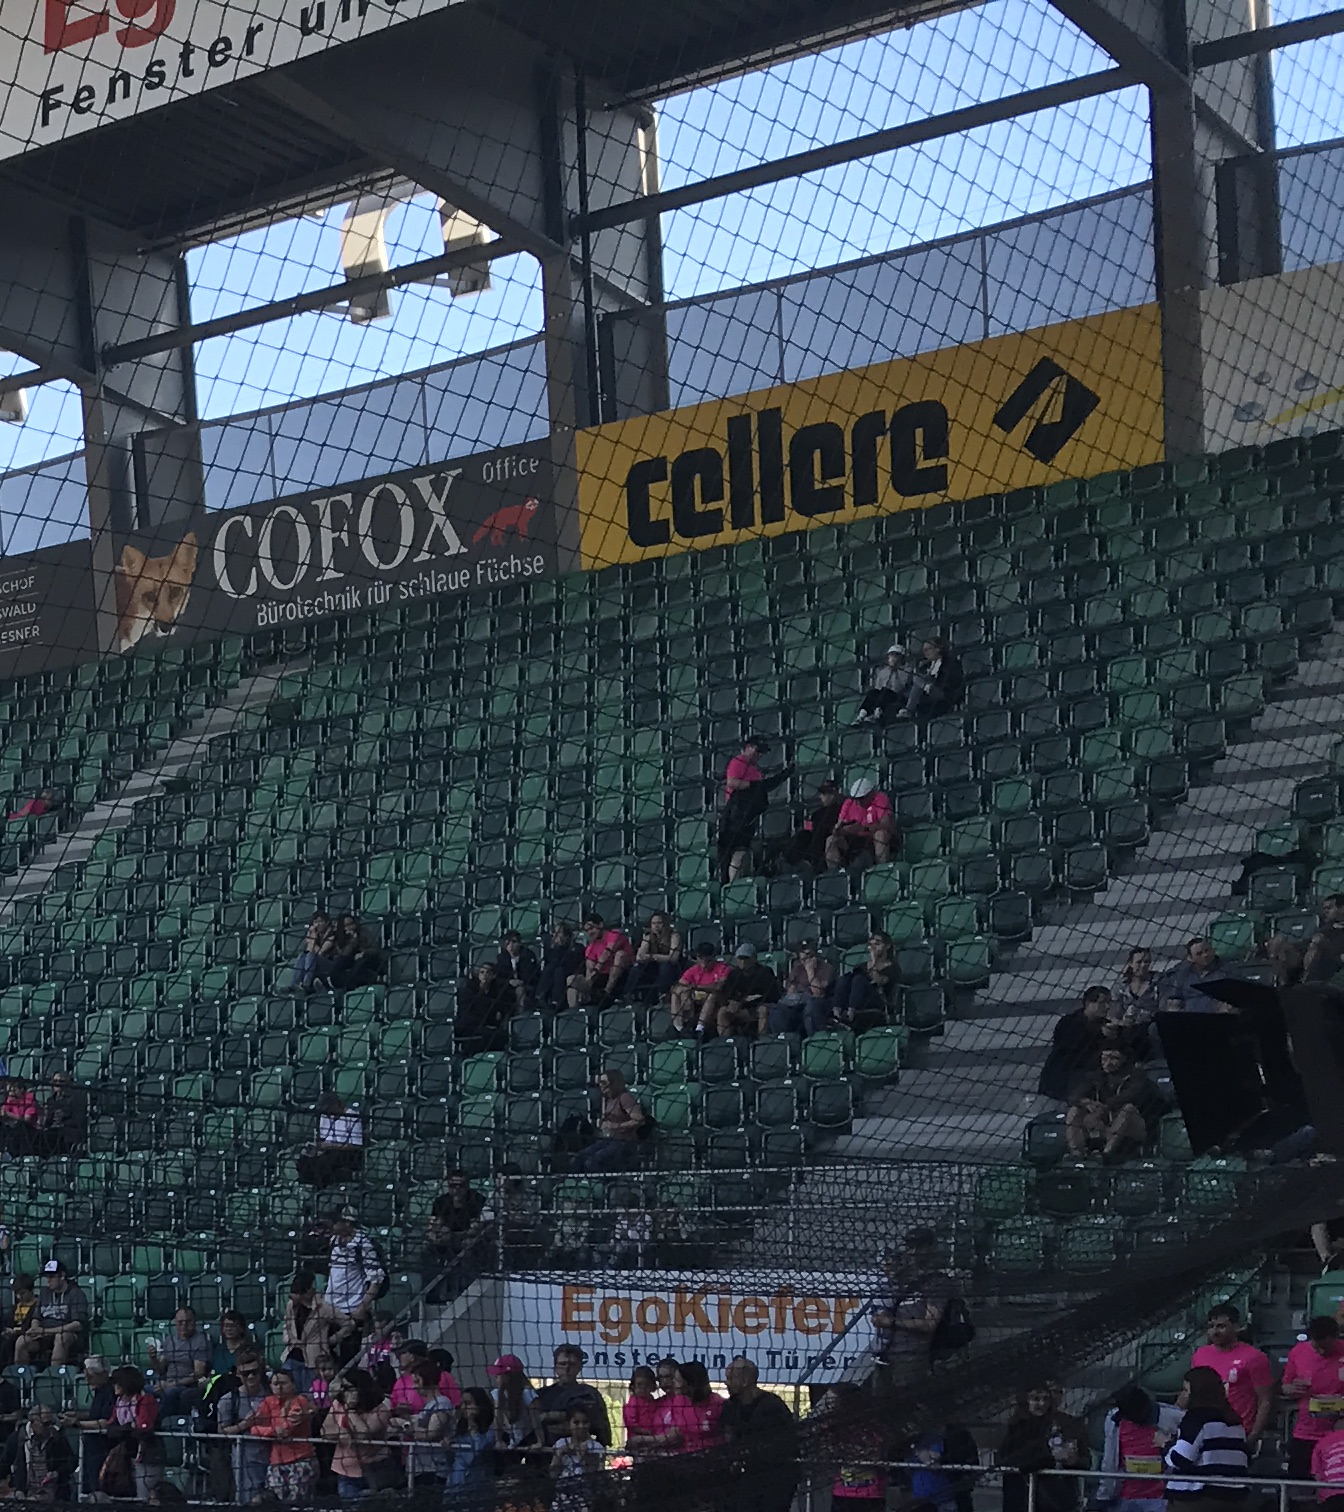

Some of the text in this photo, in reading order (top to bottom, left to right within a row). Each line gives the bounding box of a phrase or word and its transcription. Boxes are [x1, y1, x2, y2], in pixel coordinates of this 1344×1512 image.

[41, 21, 263, 127] Fenster
[301, 0, 397, 35] un
[482, 455, 540, 484] Office
[626, 400, 949, 548] cellere
[213, 468, 468, 599] COFOX
[257, 553, 545, 626] Bürotechnik für schlaue Füchse
[560, 1284, 861, 1344] EgoKiefer
[581, 1349, 675, 1368] enster
